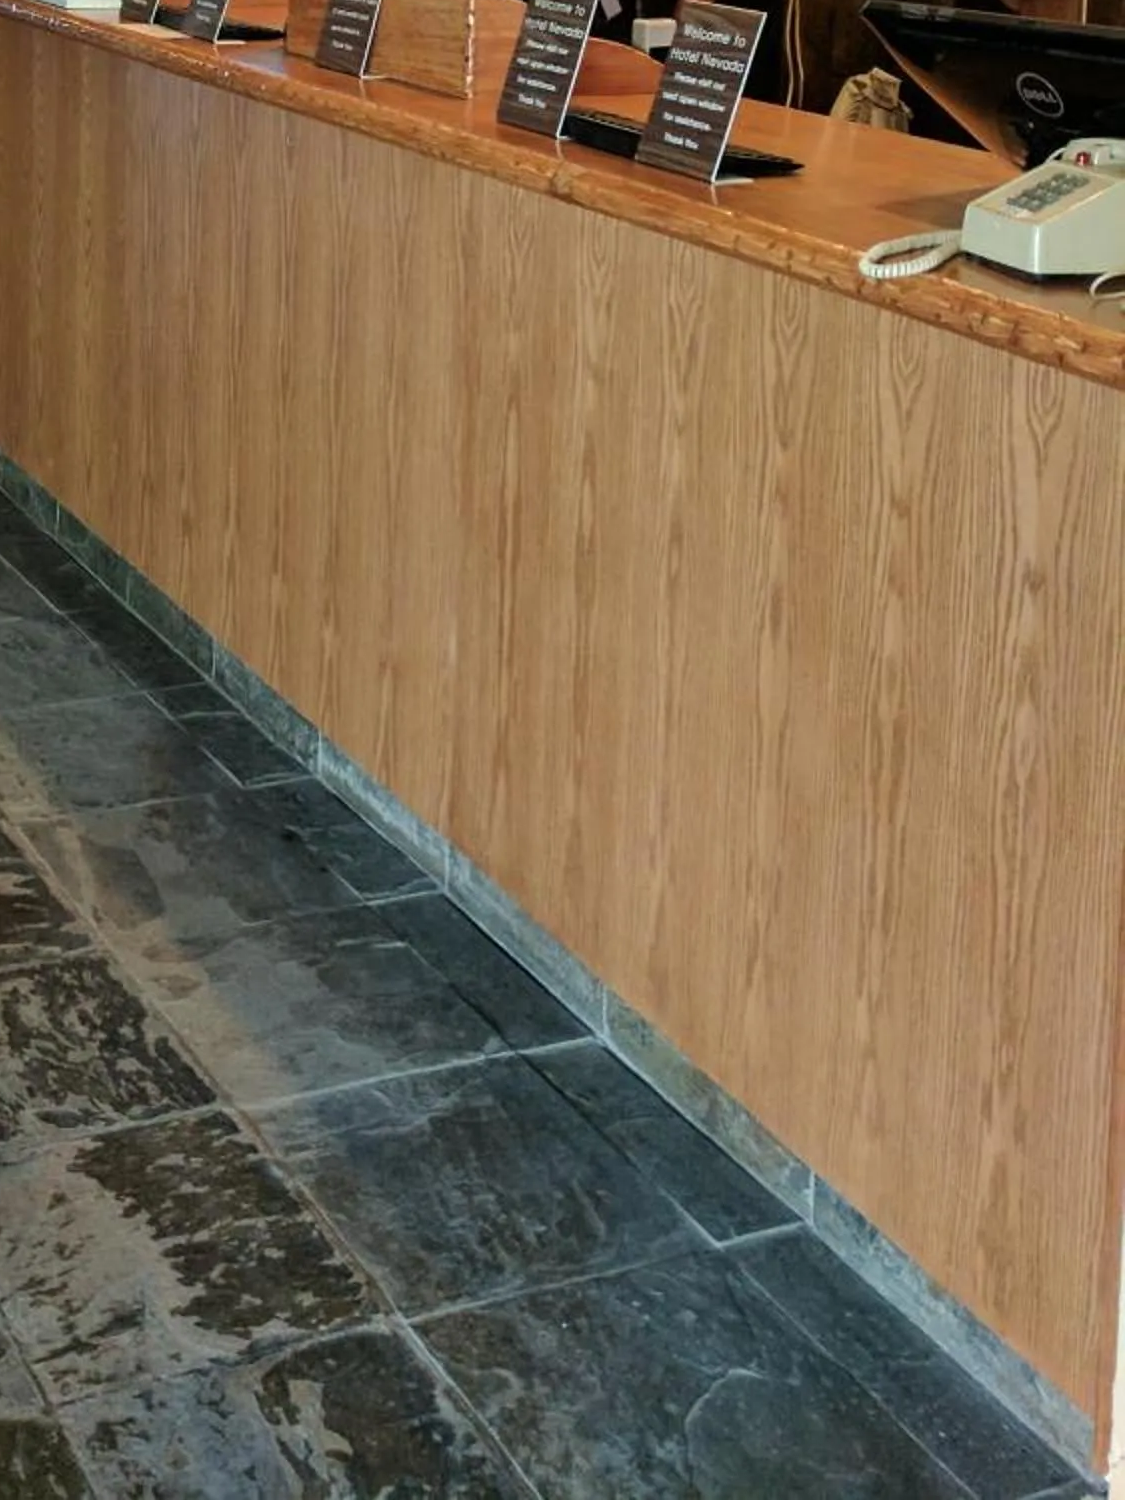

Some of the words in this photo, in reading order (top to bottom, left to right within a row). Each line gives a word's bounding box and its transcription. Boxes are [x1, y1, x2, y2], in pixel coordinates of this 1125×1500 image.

[683, 23, 732, 45] Welcome
[733, 33, 747, 49] to
[669, 47, 700, 64] Hotel
[700, 53, 745, 74] Nevada
